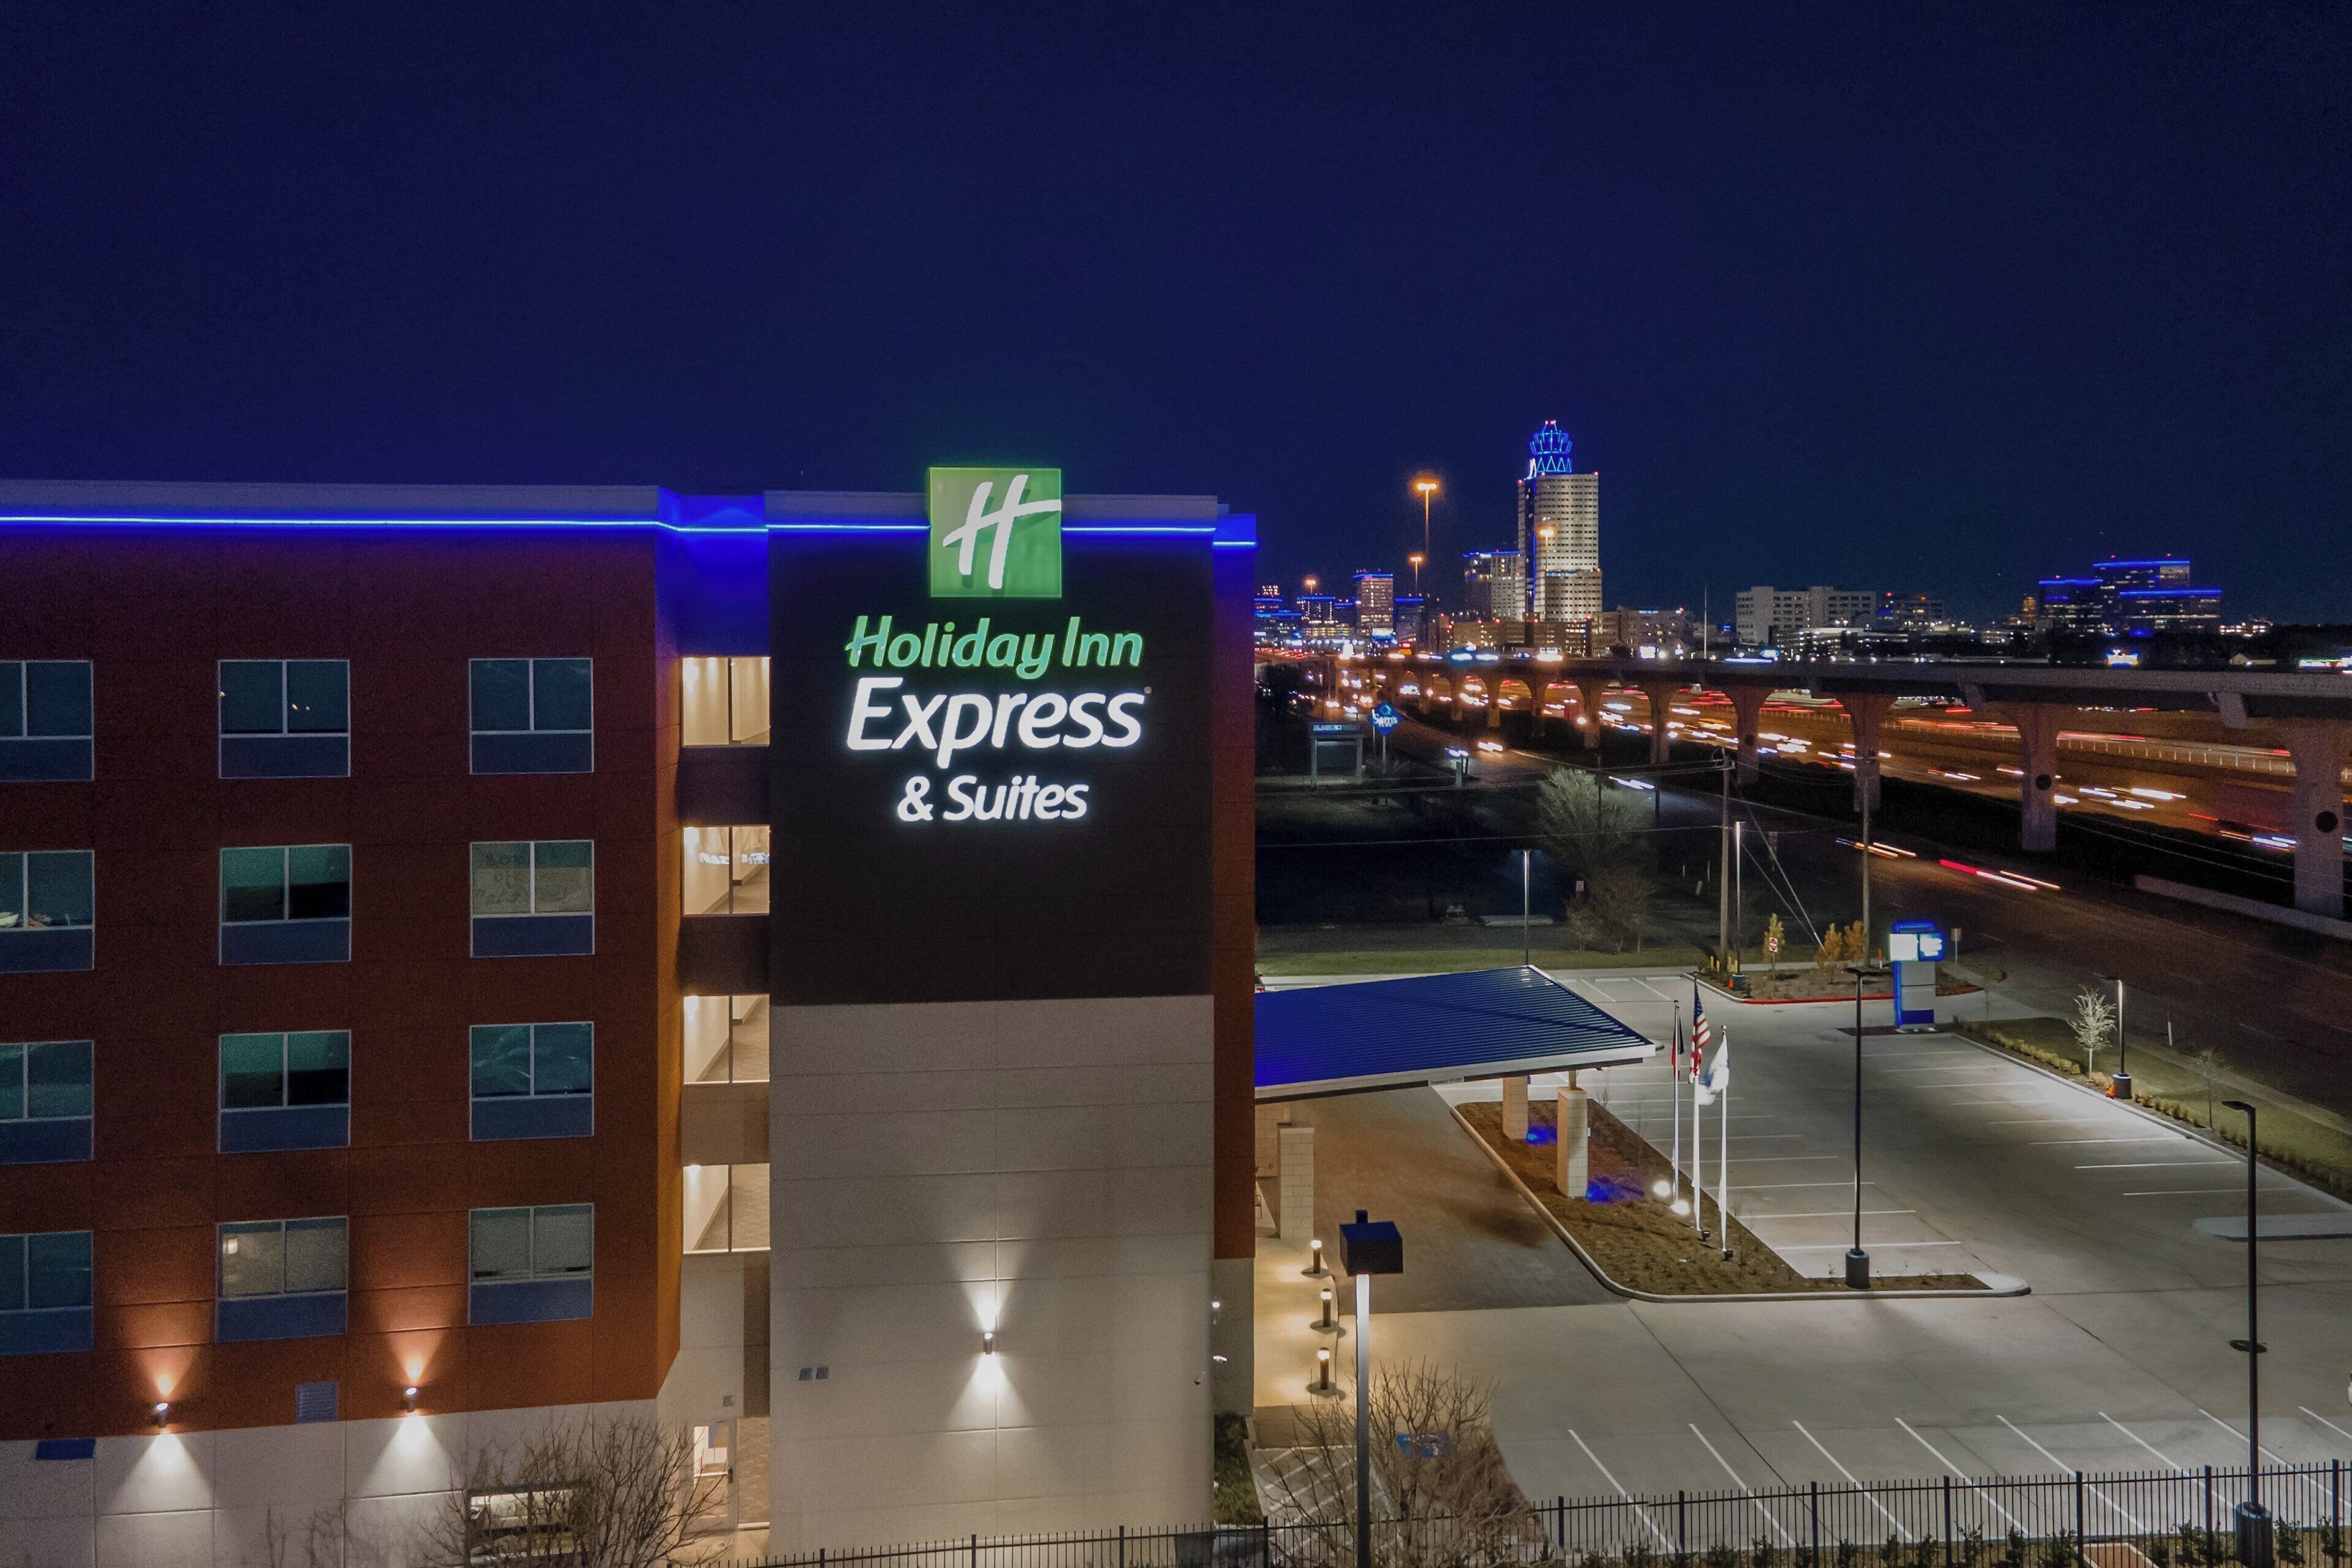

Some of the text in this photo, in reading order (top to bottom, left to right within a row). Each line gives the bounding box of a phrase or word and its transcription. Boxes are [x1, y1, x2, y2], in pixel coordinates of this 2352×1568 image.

[845, 616, 1143, 679] Holiday Inn
[847, 677, 1145, 769] Express
[897, 775, 1089, 821] & Suites
